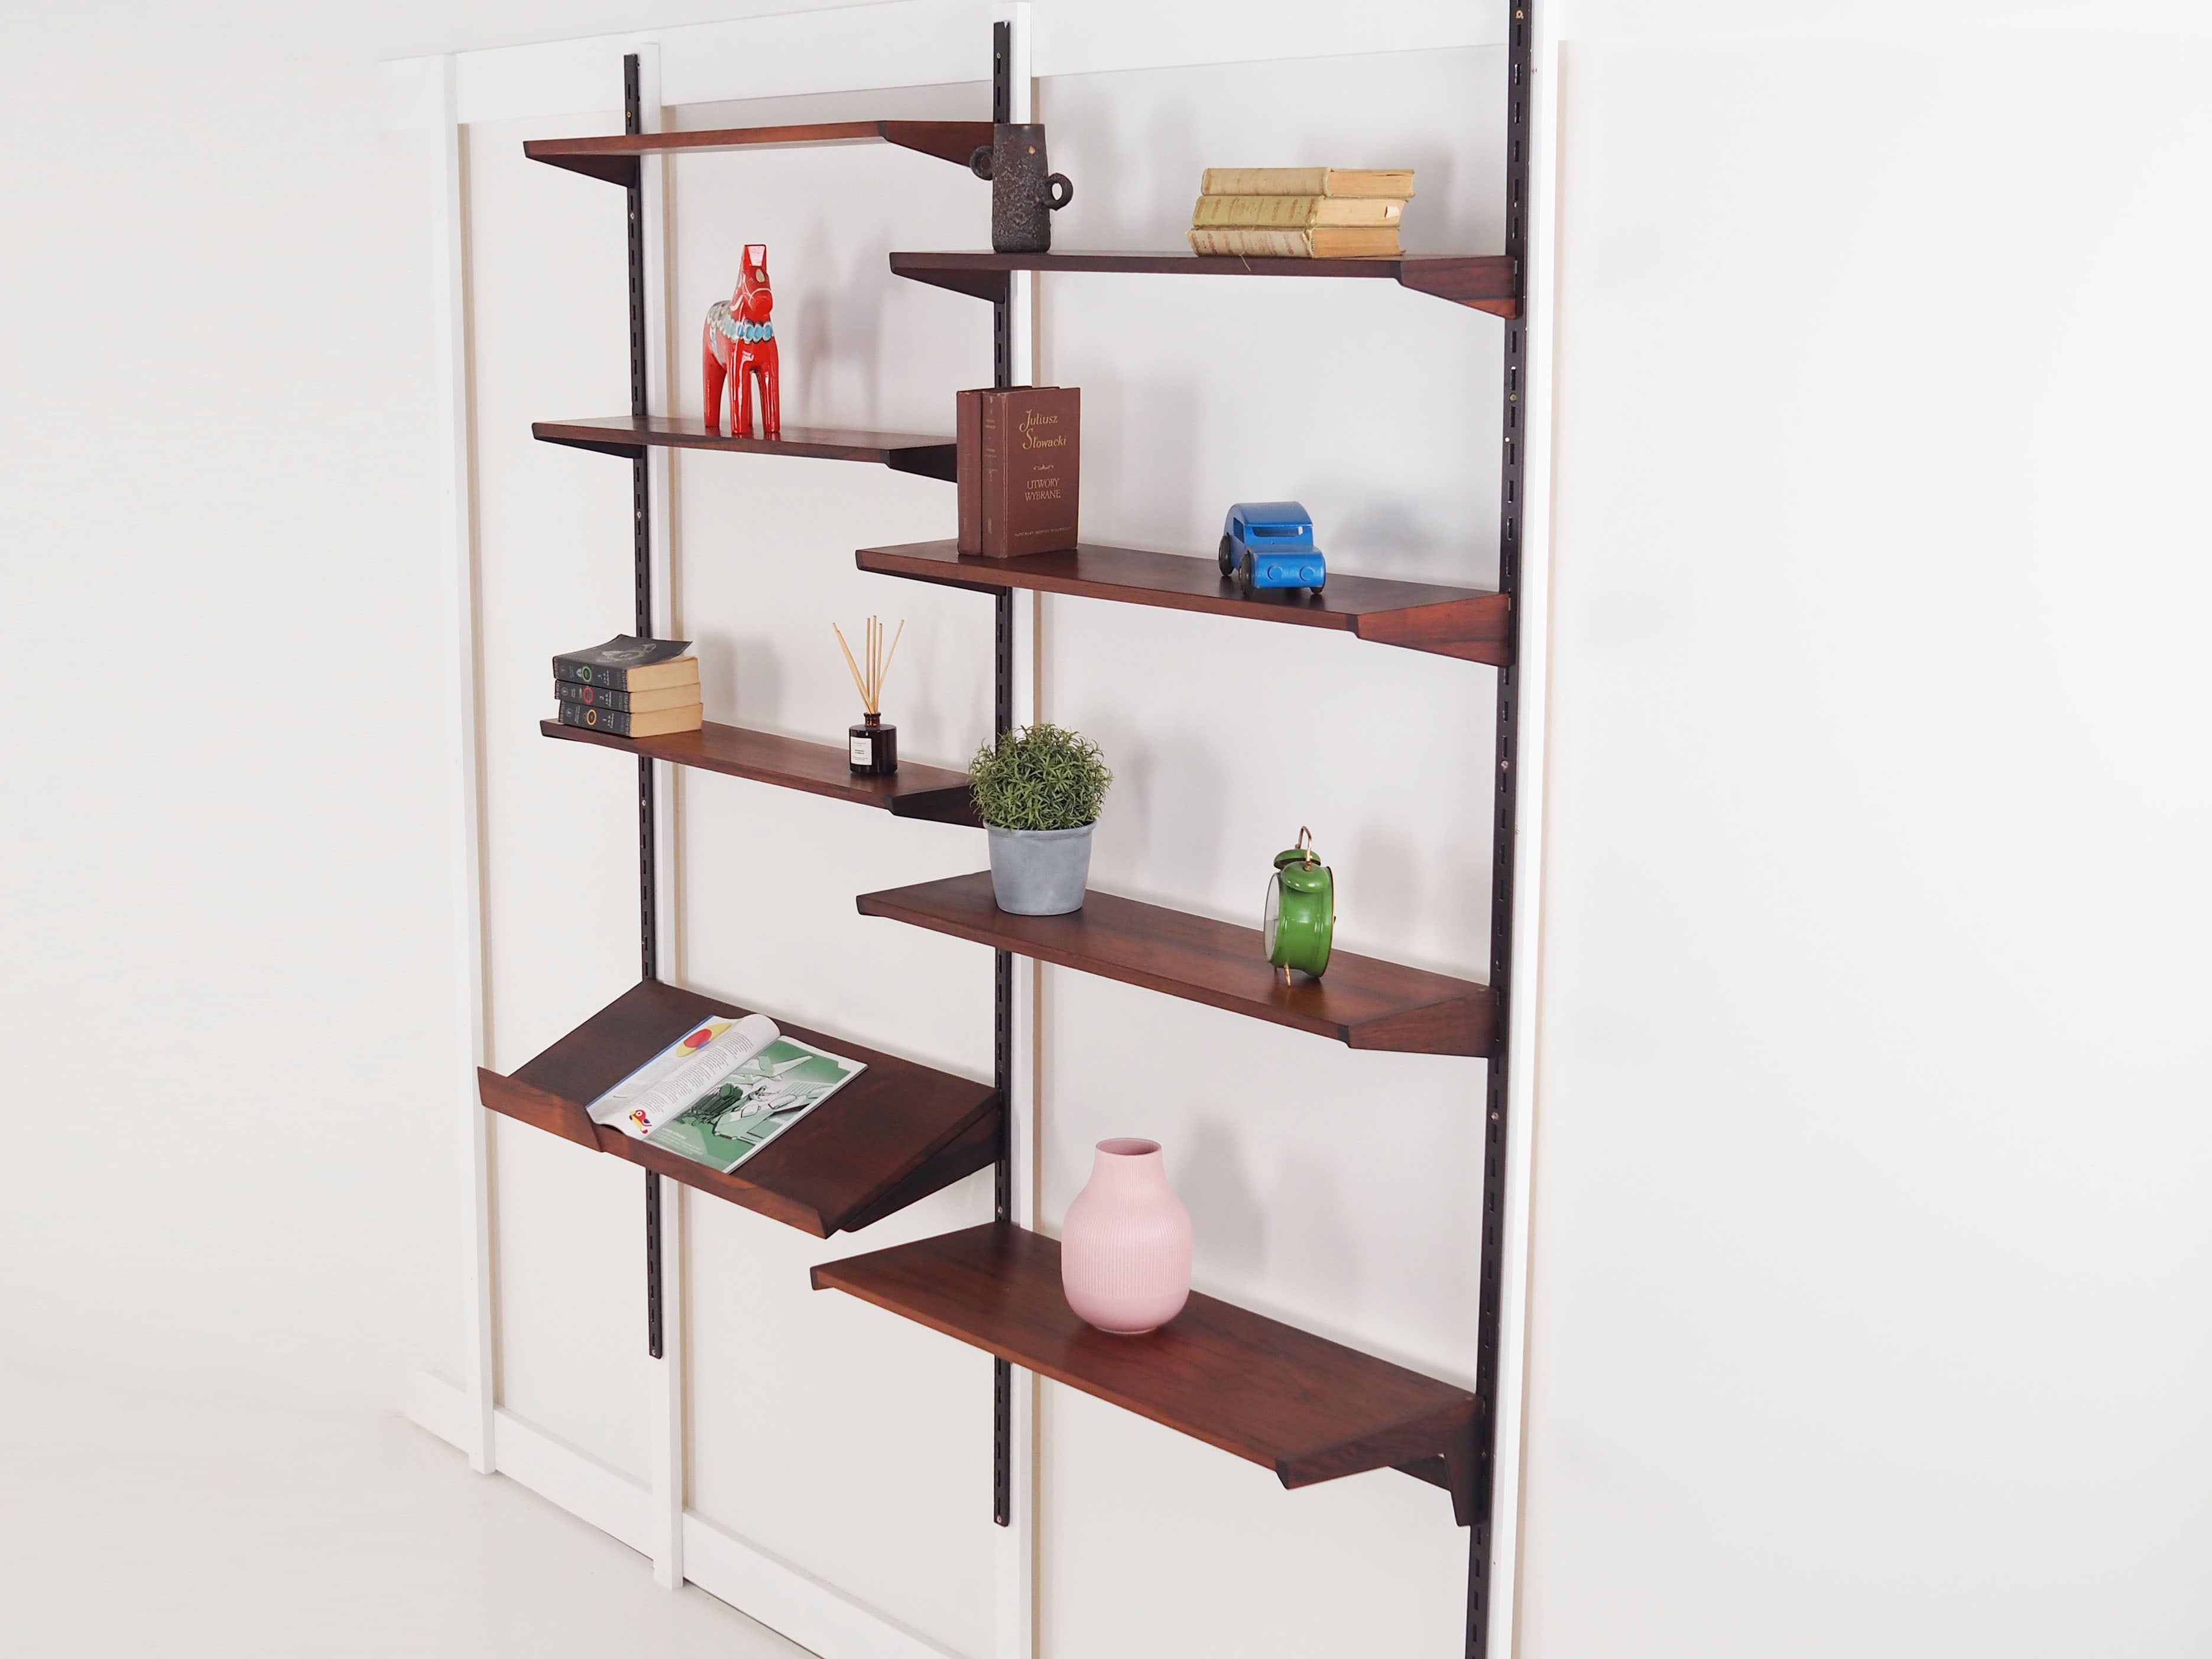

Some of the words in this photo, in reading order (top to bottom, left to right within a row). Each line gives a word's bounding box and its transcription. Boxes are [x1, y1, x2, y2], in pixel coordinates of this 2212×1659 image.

[1019, 409, 1059, 432] Juliusz
[1027, 478, 1059, 490] UTWORY
[1024, 489, 1060, 502] WYBRANE
